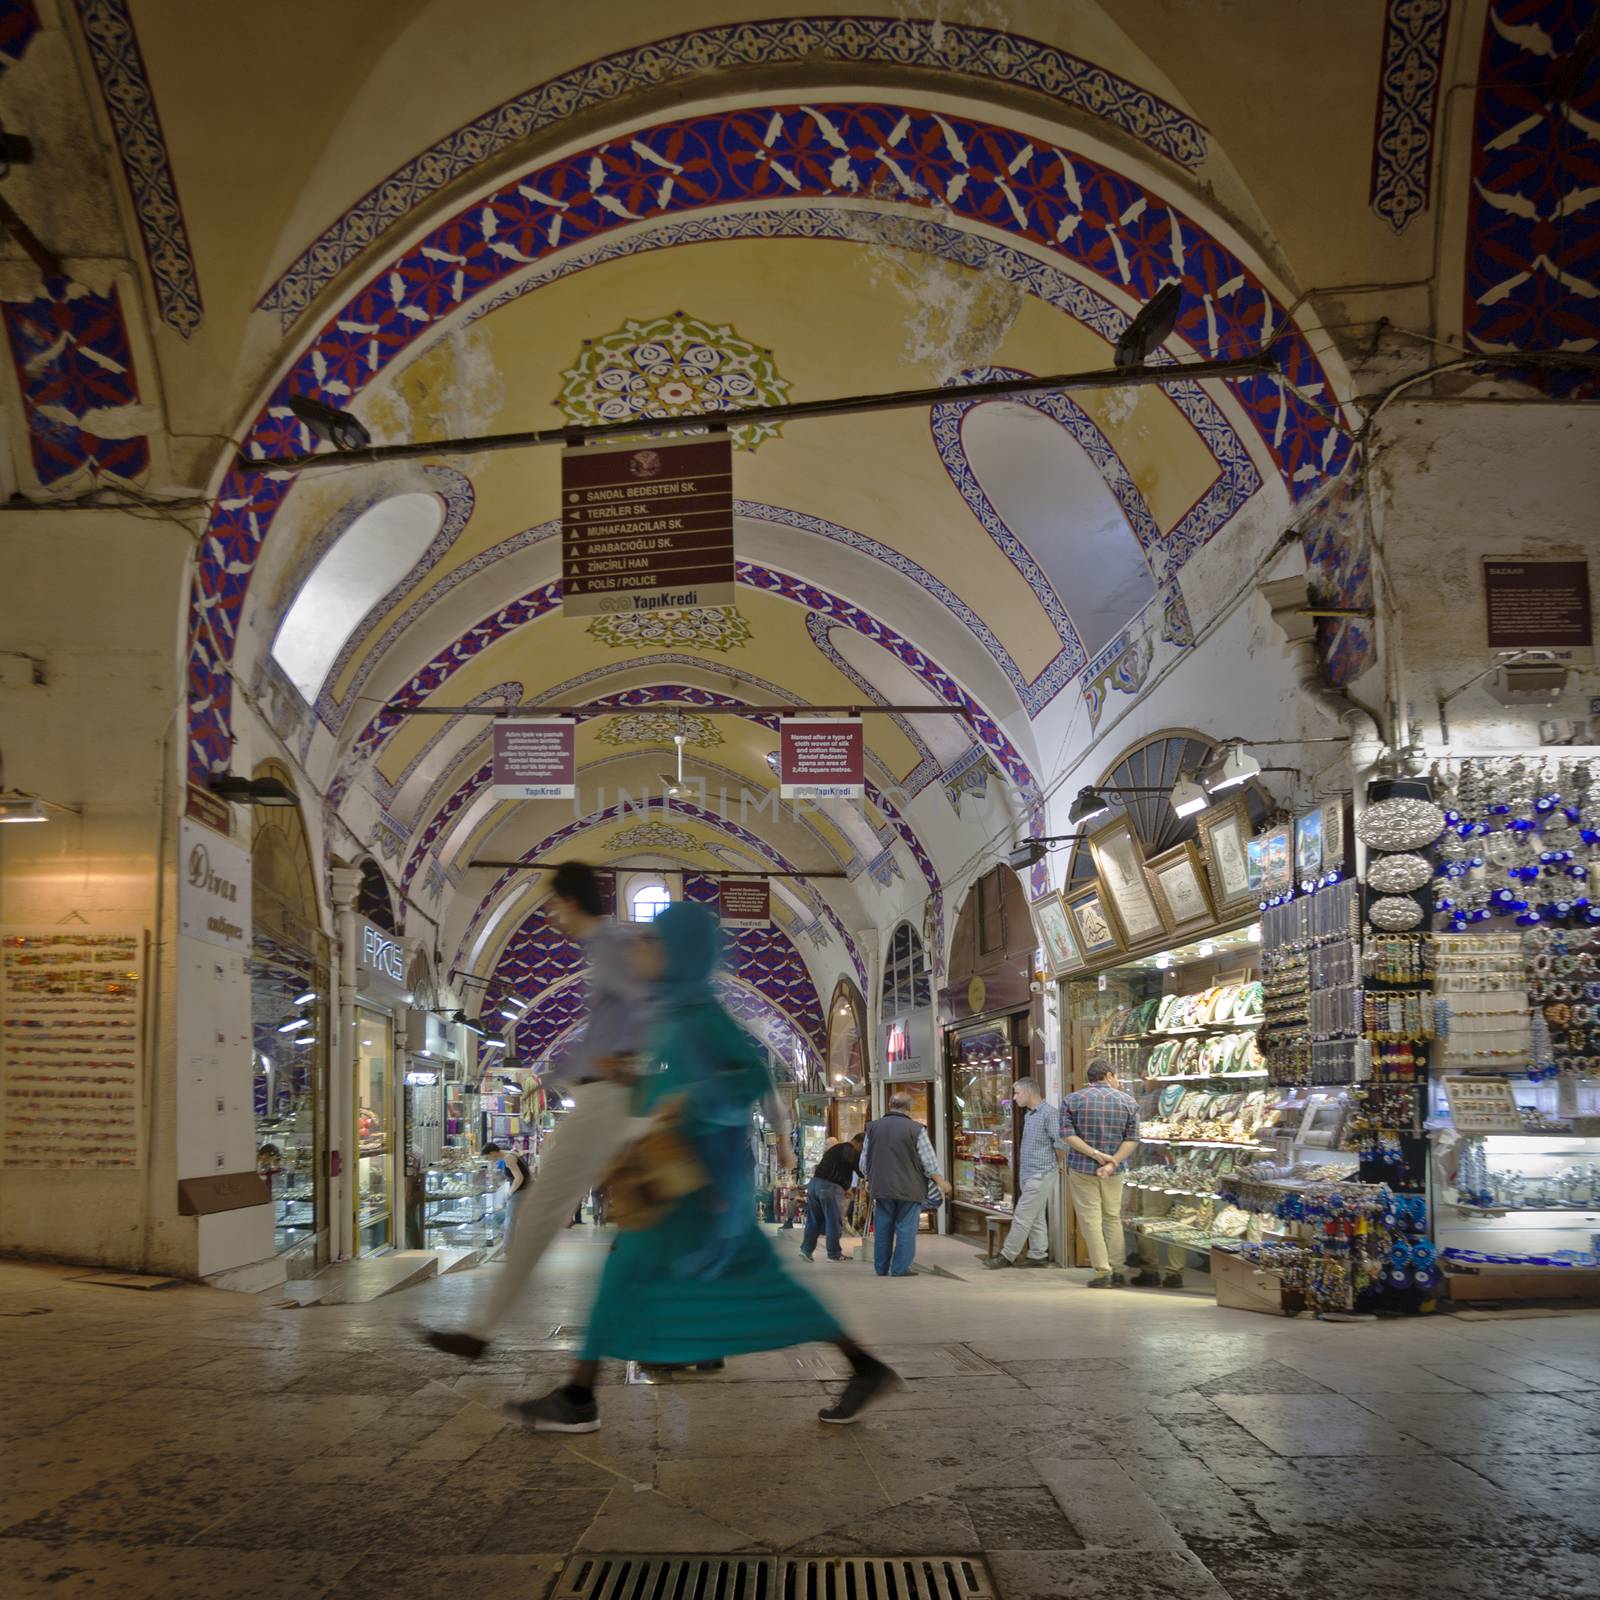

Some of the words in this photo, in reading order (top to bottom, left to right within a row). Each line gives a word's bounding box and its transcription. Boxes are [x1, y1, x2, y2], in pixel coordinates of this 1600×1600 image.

[587, 489, 625, 501] SANDAL
[627, 482, 680, 498] BEDESTENİ
[681, 482, 697, 494] SK.
[587, 505, 631, 519] TERZİLER
[633, 504, 649, 515] SK.
[587, 521, 667, 537] MUHAFAZACILAR
[669, 519, 684, 530] SK.
[588, 540, 656, 555] ARABACIOĞLU
[657, 538, 674, 549] SK.
[587, 559, 626, 573] ZİNCİRLİ
[628, 558, 648, 570] HAN
[588, 577, 616, 590] POLİS
[623, 575, 657, 587] POLICE
[633, 591, 698, 609] YapıKredi
